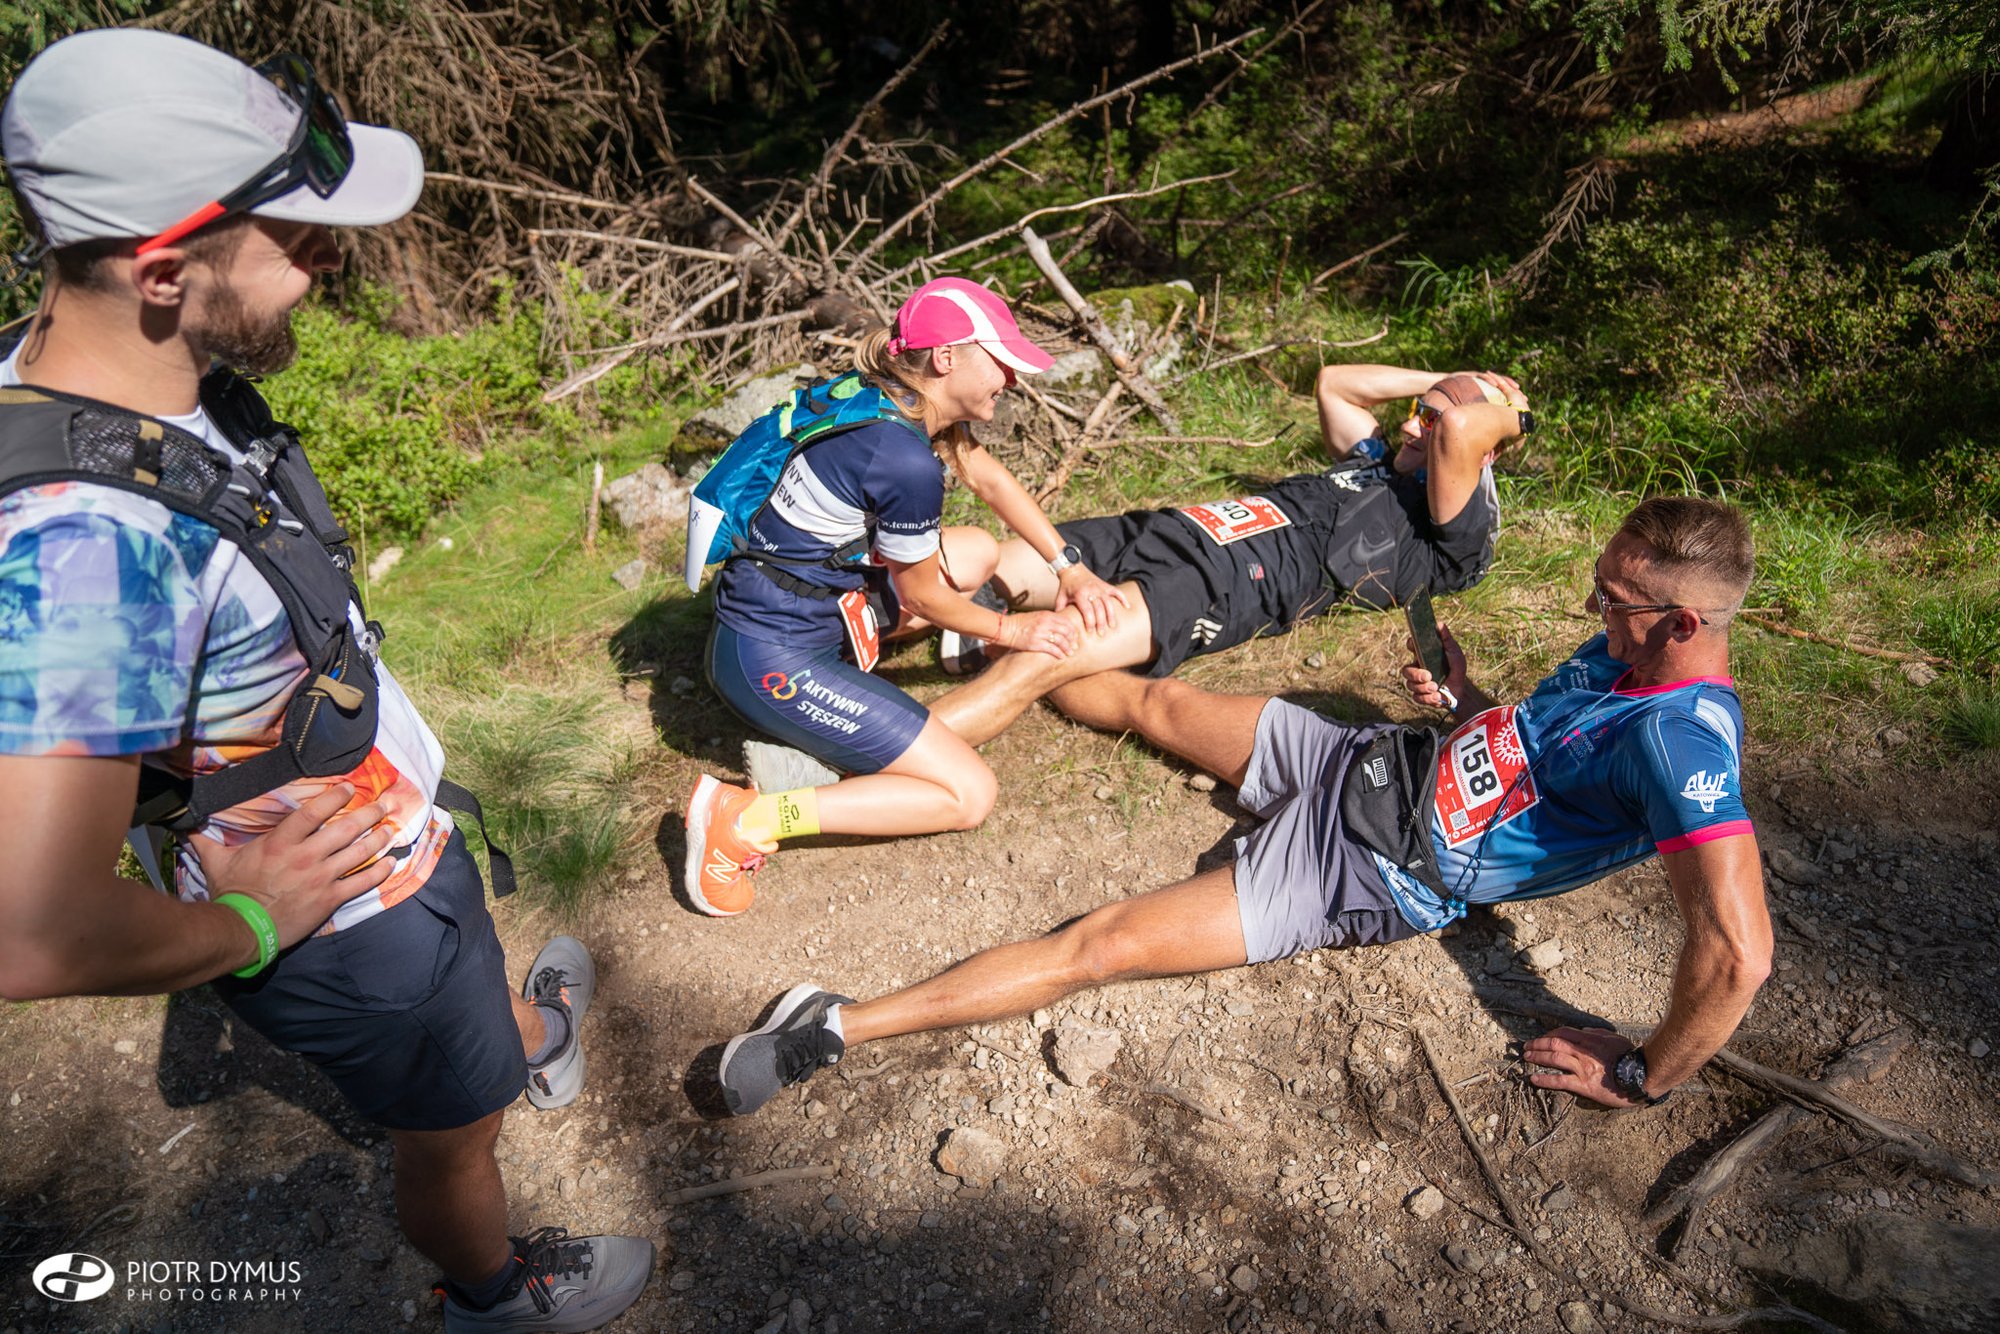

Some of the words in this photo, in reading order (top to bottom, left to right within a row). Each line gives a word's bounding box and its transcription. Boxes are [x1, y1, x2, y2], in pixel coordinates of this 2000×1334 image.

[801, 679, 869, 717] AKTYWNY
[796, 700, 863, 735] STĘSZEW
[1373, 759, 1388, 786] PUMA
[1460, 733, 1498, 797] 158
[1684, 770, 1728, 791] AWF
[783, 795, 791, 833] KGHM
